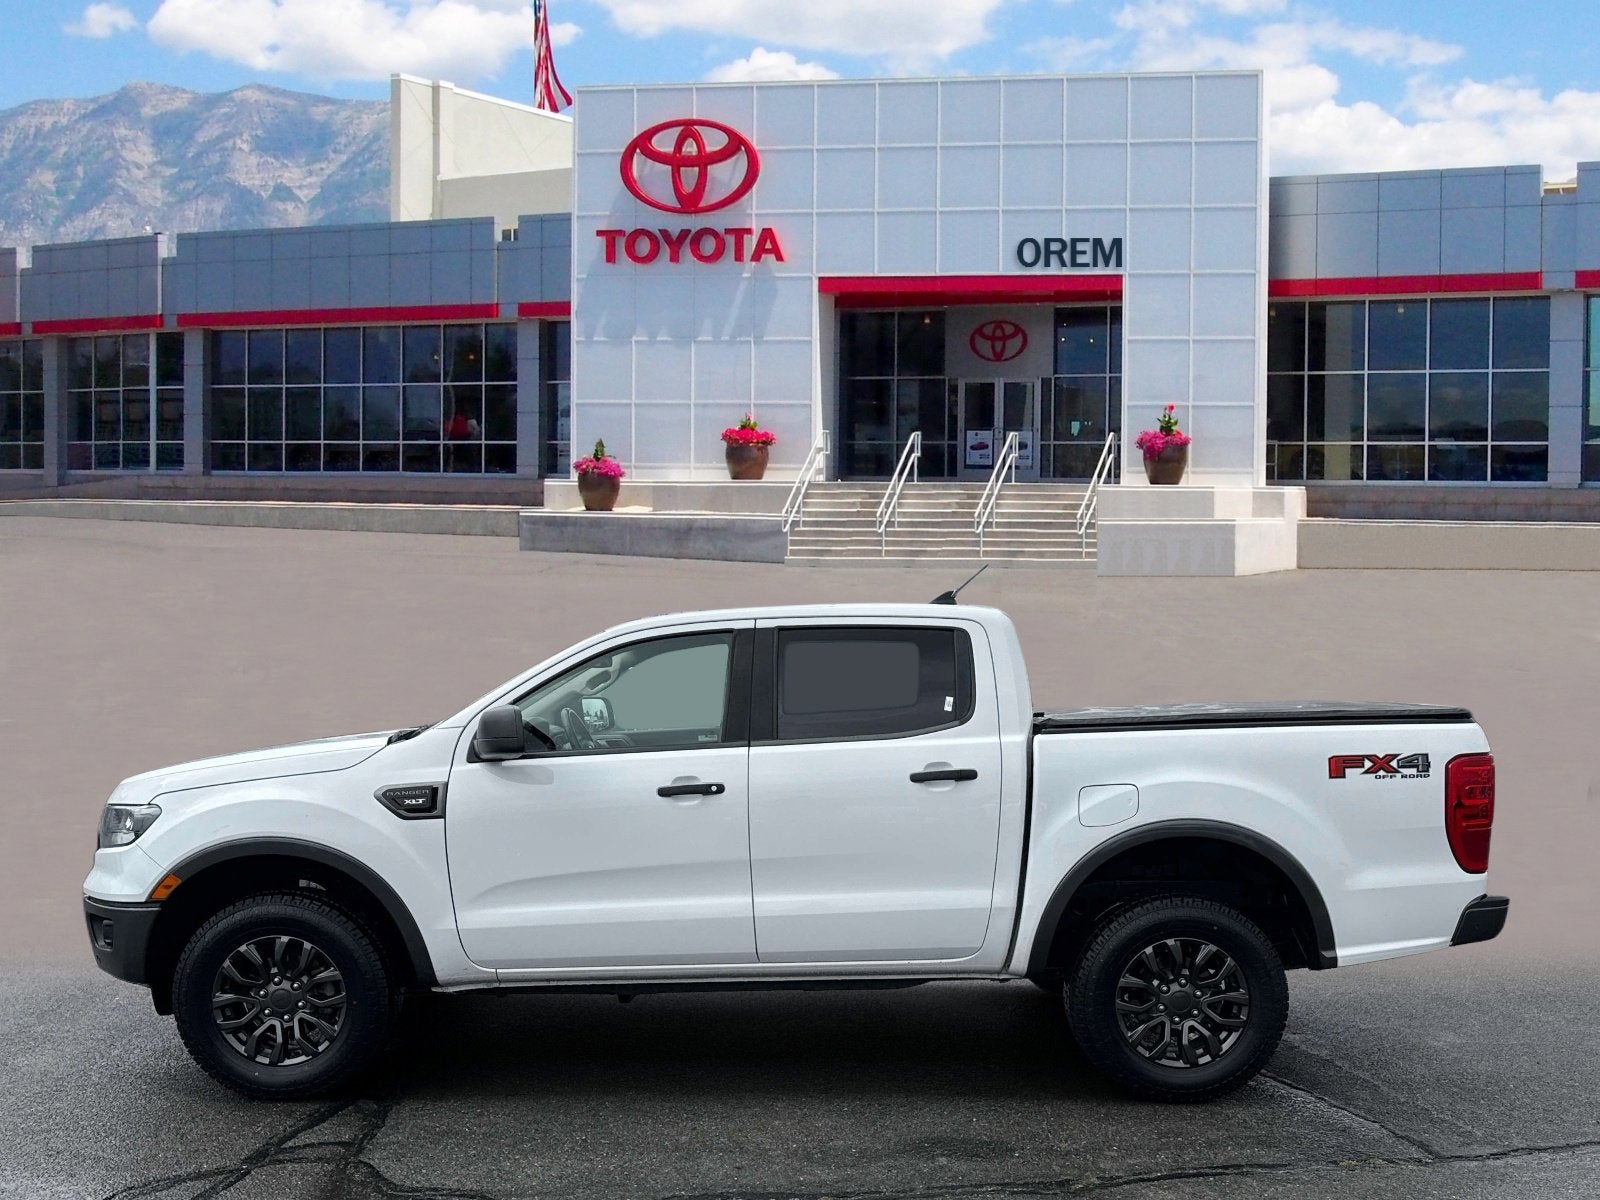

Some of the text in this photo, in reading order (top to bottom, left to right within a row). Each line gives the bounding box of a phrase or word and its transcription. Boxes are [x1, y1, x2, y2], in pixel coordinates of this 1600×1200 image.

[596, 227, 785, 265] TOYOTA
[1016, 237, 1123, 268] OREM
[1328, 753, 1431, 779] FX4
[386, 789, 429, 797] RANGER
